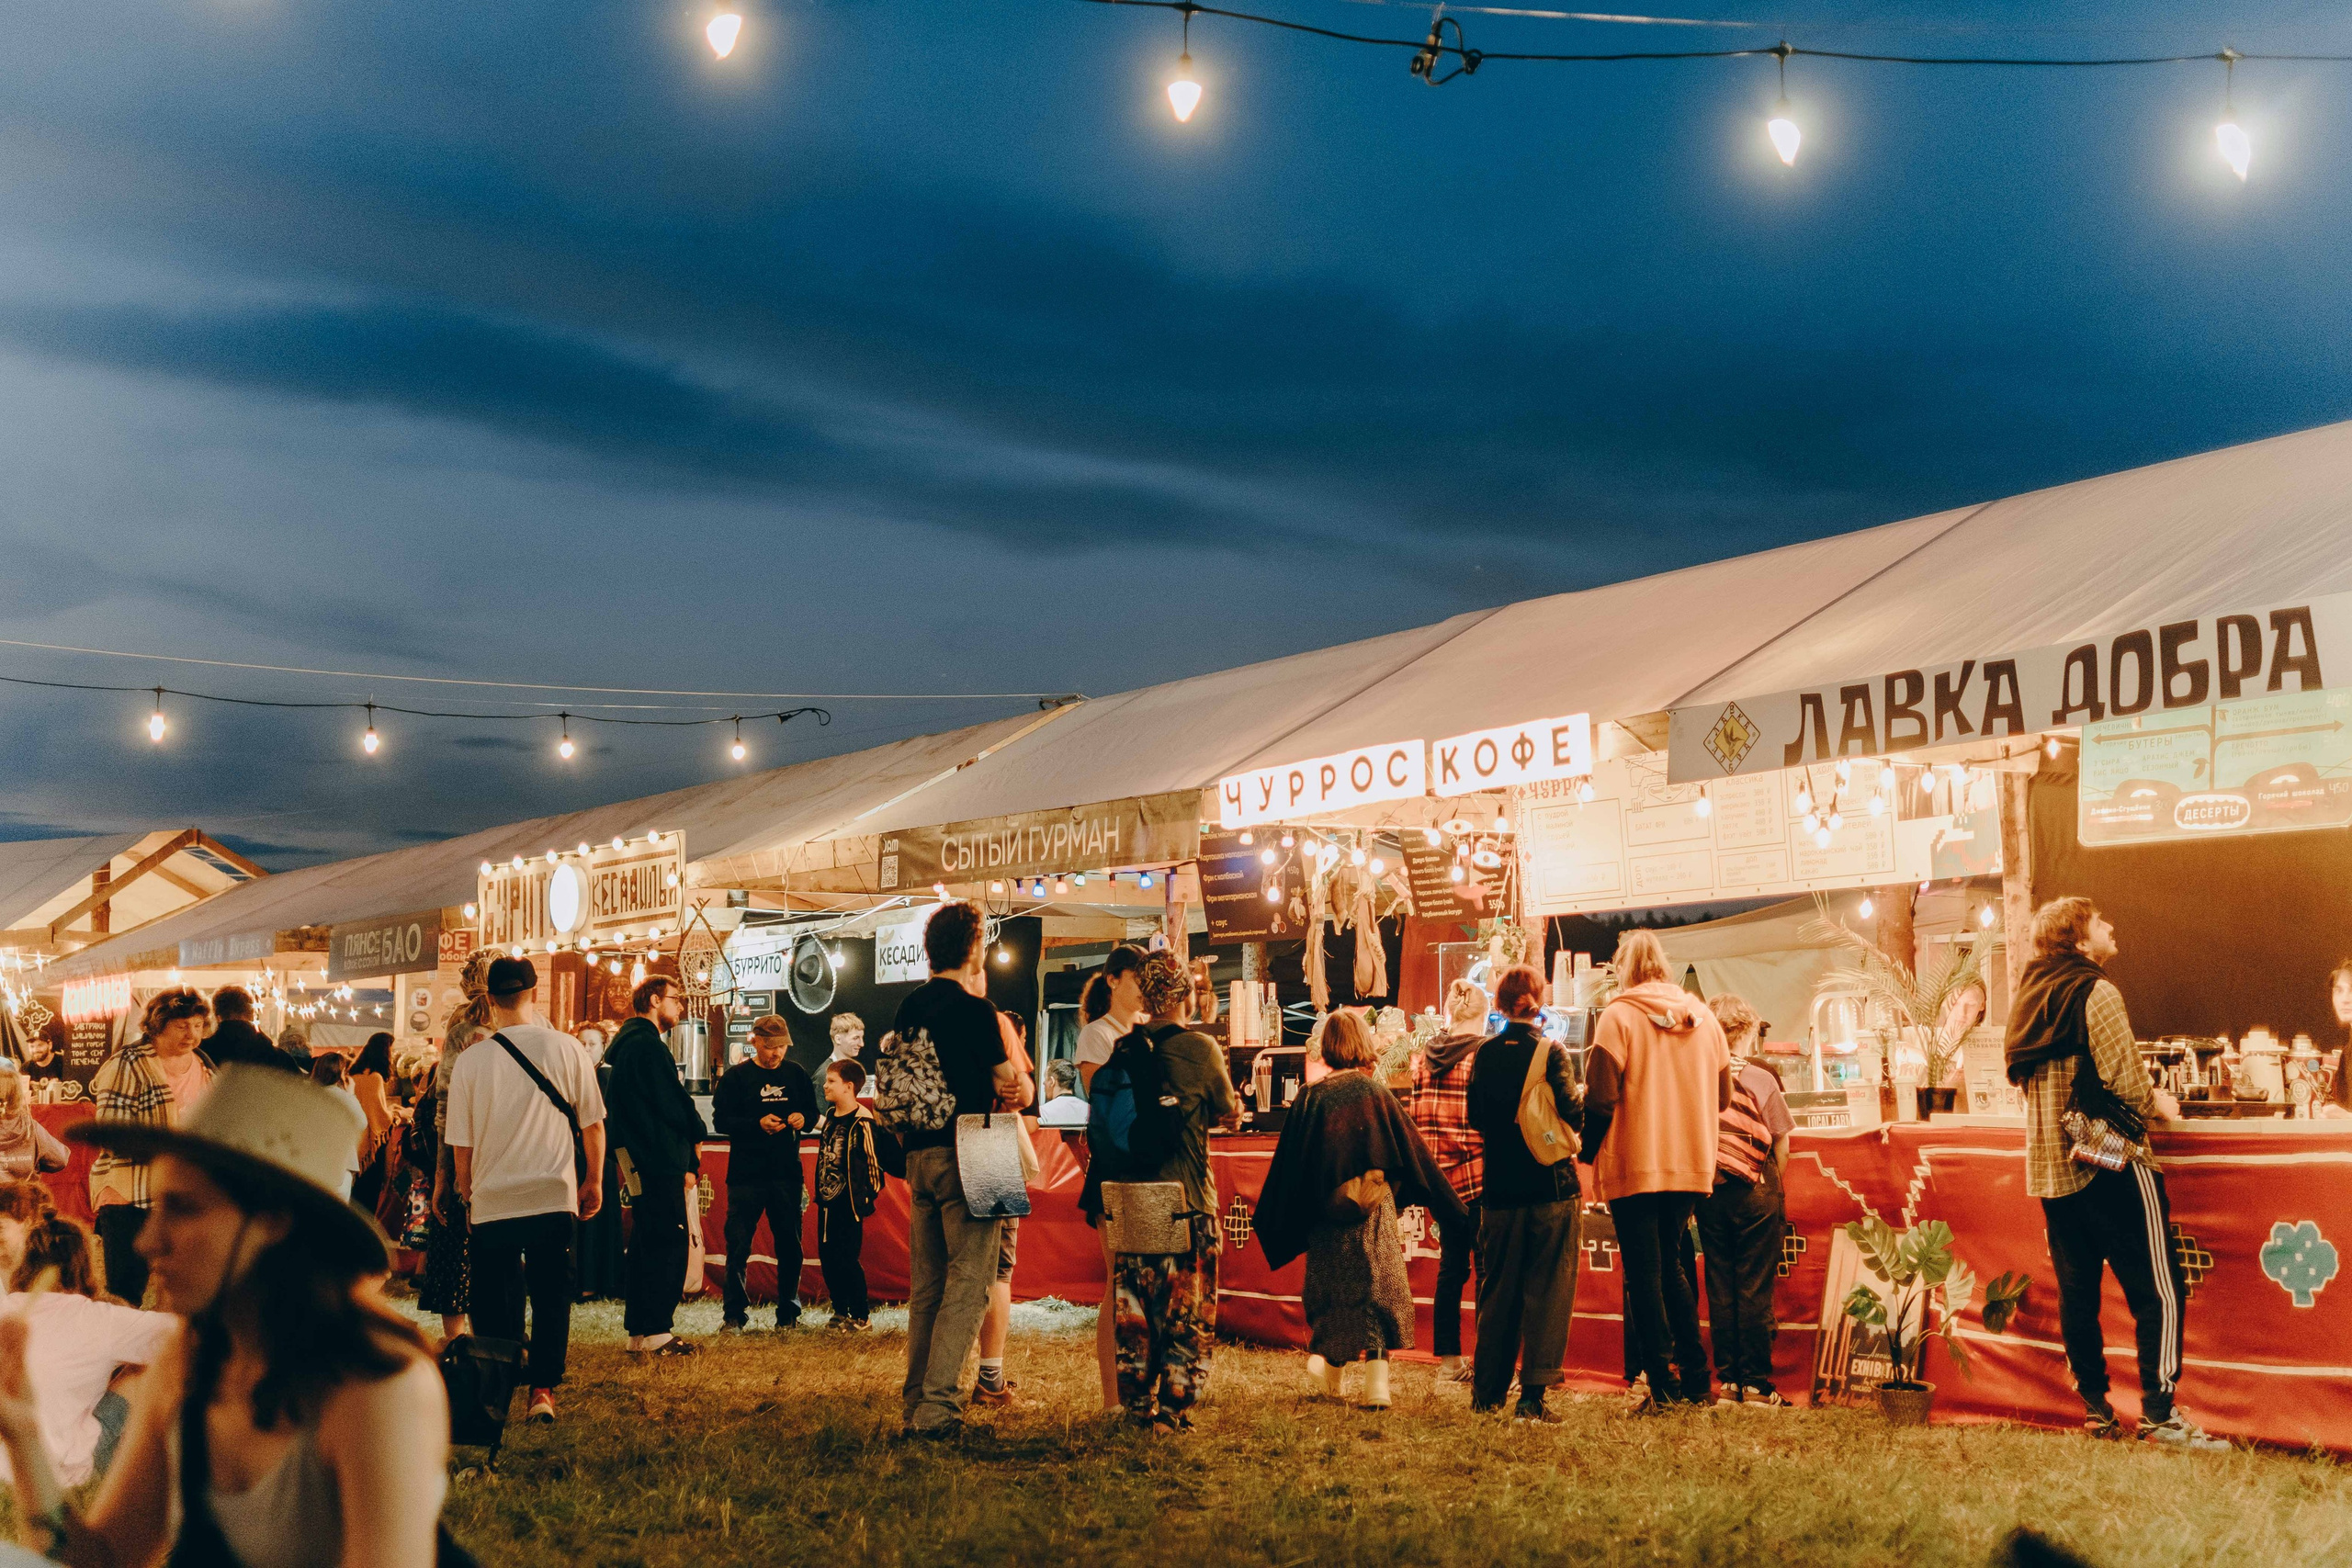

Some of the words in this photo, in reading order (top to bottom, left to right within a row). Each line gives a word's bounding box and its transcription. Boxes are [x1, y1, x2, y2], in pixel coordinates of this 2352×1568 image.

[1784, 659, 2025, 767] ЛАВКА
[2052, 604, 2323, 725] ДОБРА
[2264, 704, 2279, 712] БУМ
[1713, 705, 1750, 736] ЛАВКА
[2128, 737, 2173, 750] БУТЕРЫ
[1712, 742, 1751, 772] ДОБРА
[2101, 758, 2120, 766] СЫРА
[2142, 753, 2169, 762] АРАХИС
[2173, 750, 2195, 759] ДЖЕМ
[1226, 749, 1408, 817] ЧУРРОС
[1441, 724, 1572, 784] КОФЕ
[2093, 769, 2107, 777] РИС
[2142, 761, 2178, 773] СЕЗОННЫЙ
[1726, 774, 1764, 787] классика
[2258, 789, 2289, 800] Горячий
[2291, 788, 2324, 797] шоколад
[2329, 782, 2349, 795] 450
[2184, 806, 2240, 822] ДЕСЕРТЫ
[941, 822, 1022, 873] СЫТЫЙ
[1028, 816, 1120, 863] ГУРМАН
[1203, 874, 1214, 884] Фри
[483, 869, 558, 946] БУРИТ
[1206, 895, 1217, 904] Фри
[1216, 919, 1227, 928] соус
[345, 931, 381, 957] ПЯНСЕ
[382, 922, 422, 965] БАО
[440, 931, 468, 952] ФЕ
[440, 952, 468, 962] обой
[879, 943, 928, 966] КЕСАДИ
[734, 956, 781, 978] БУРРИТО
[1807, 1114, 1829, 1127] LOCAL
